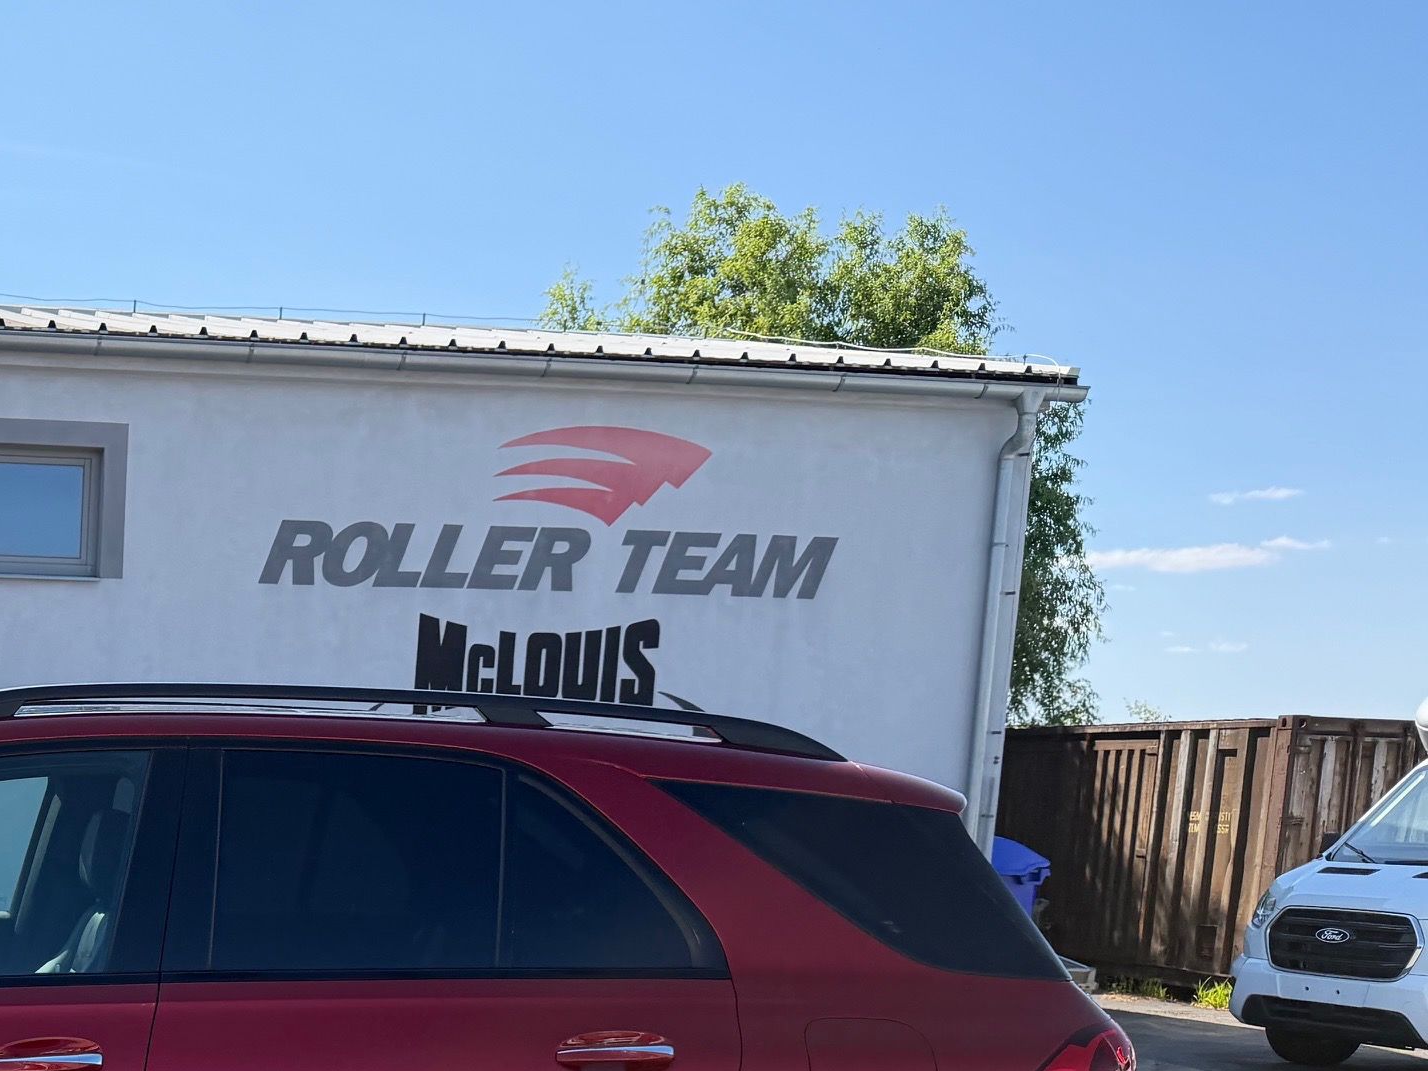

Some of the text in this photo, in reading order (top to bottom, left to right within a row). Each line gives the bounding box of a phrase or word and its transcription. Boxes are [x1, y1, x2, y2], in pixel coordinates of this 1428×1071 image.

[258, 519, 839, 600] ROLLER TEAM
[412, 612, 660, 714] McLOUIS
[1321, 930, 1343, 940] Ford
